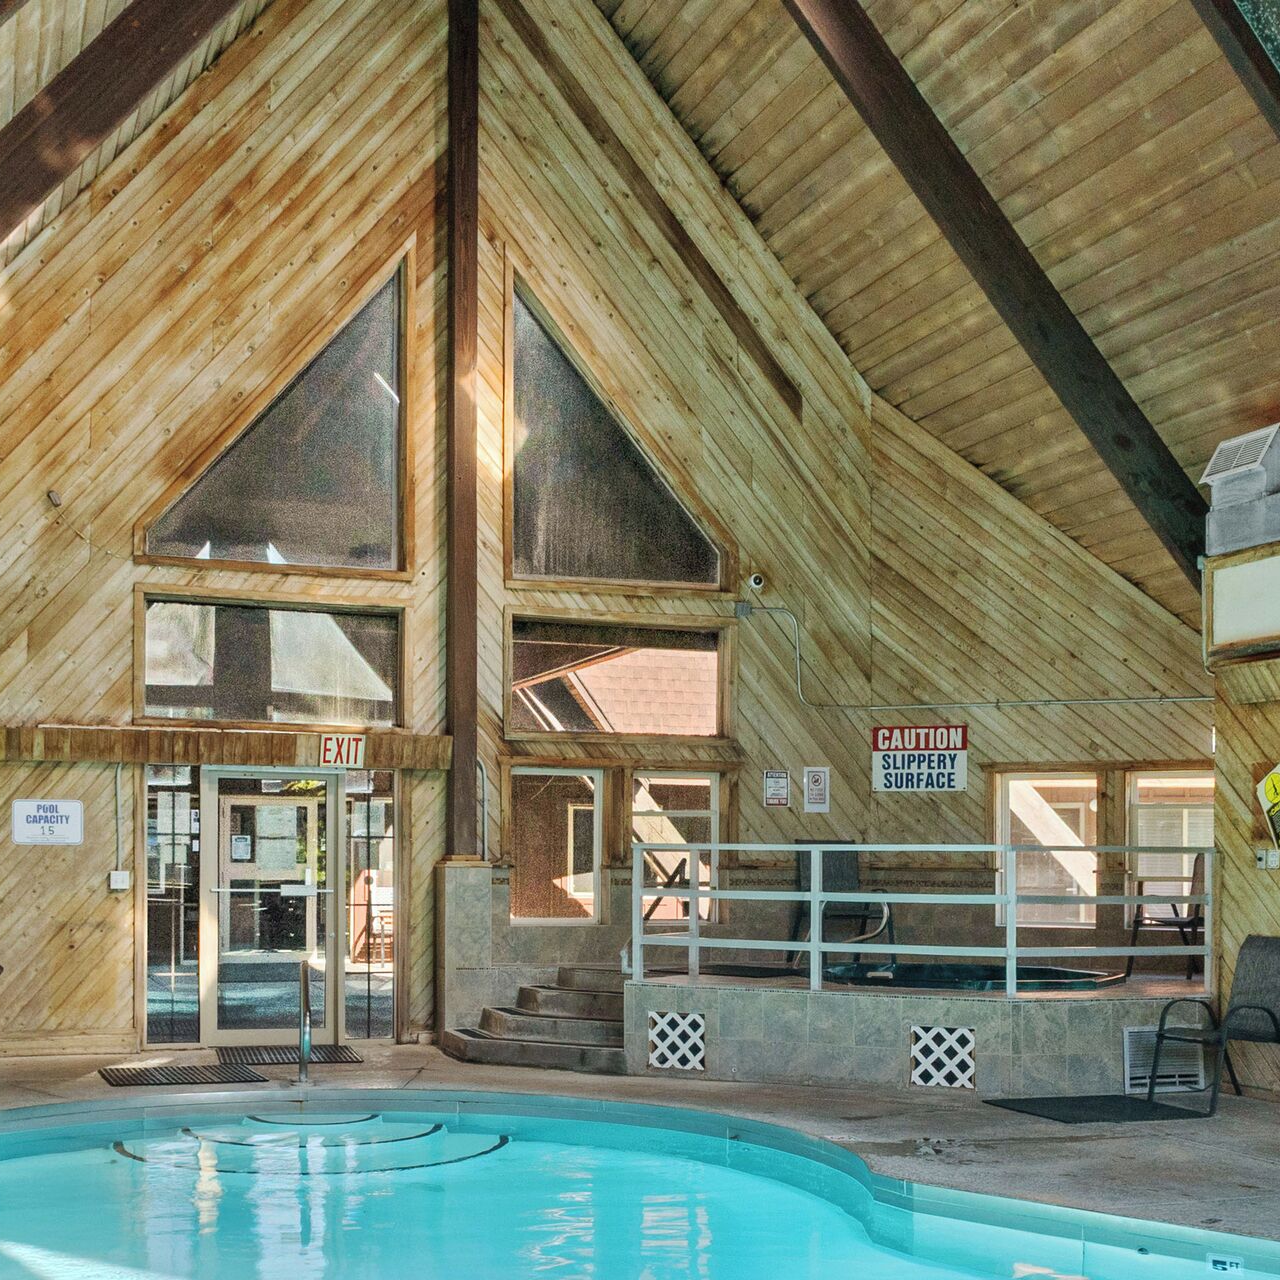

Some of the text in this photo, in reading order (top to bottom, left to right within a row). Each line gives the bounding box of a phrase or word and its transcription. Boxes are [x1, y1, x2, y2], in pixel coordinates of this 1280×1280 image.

[878, 728, 962, 749] CAUTION
[323, 738, 362, 764] EXIT
[882, 754, 957, 770] SLIPPERY
[884, 773, 955, 788] SURFACE
[37, 804, 59, 813] POOL
[26, 815, 70, 824] CAPACITY
[1212, 1260, 1227, 1271] 5
